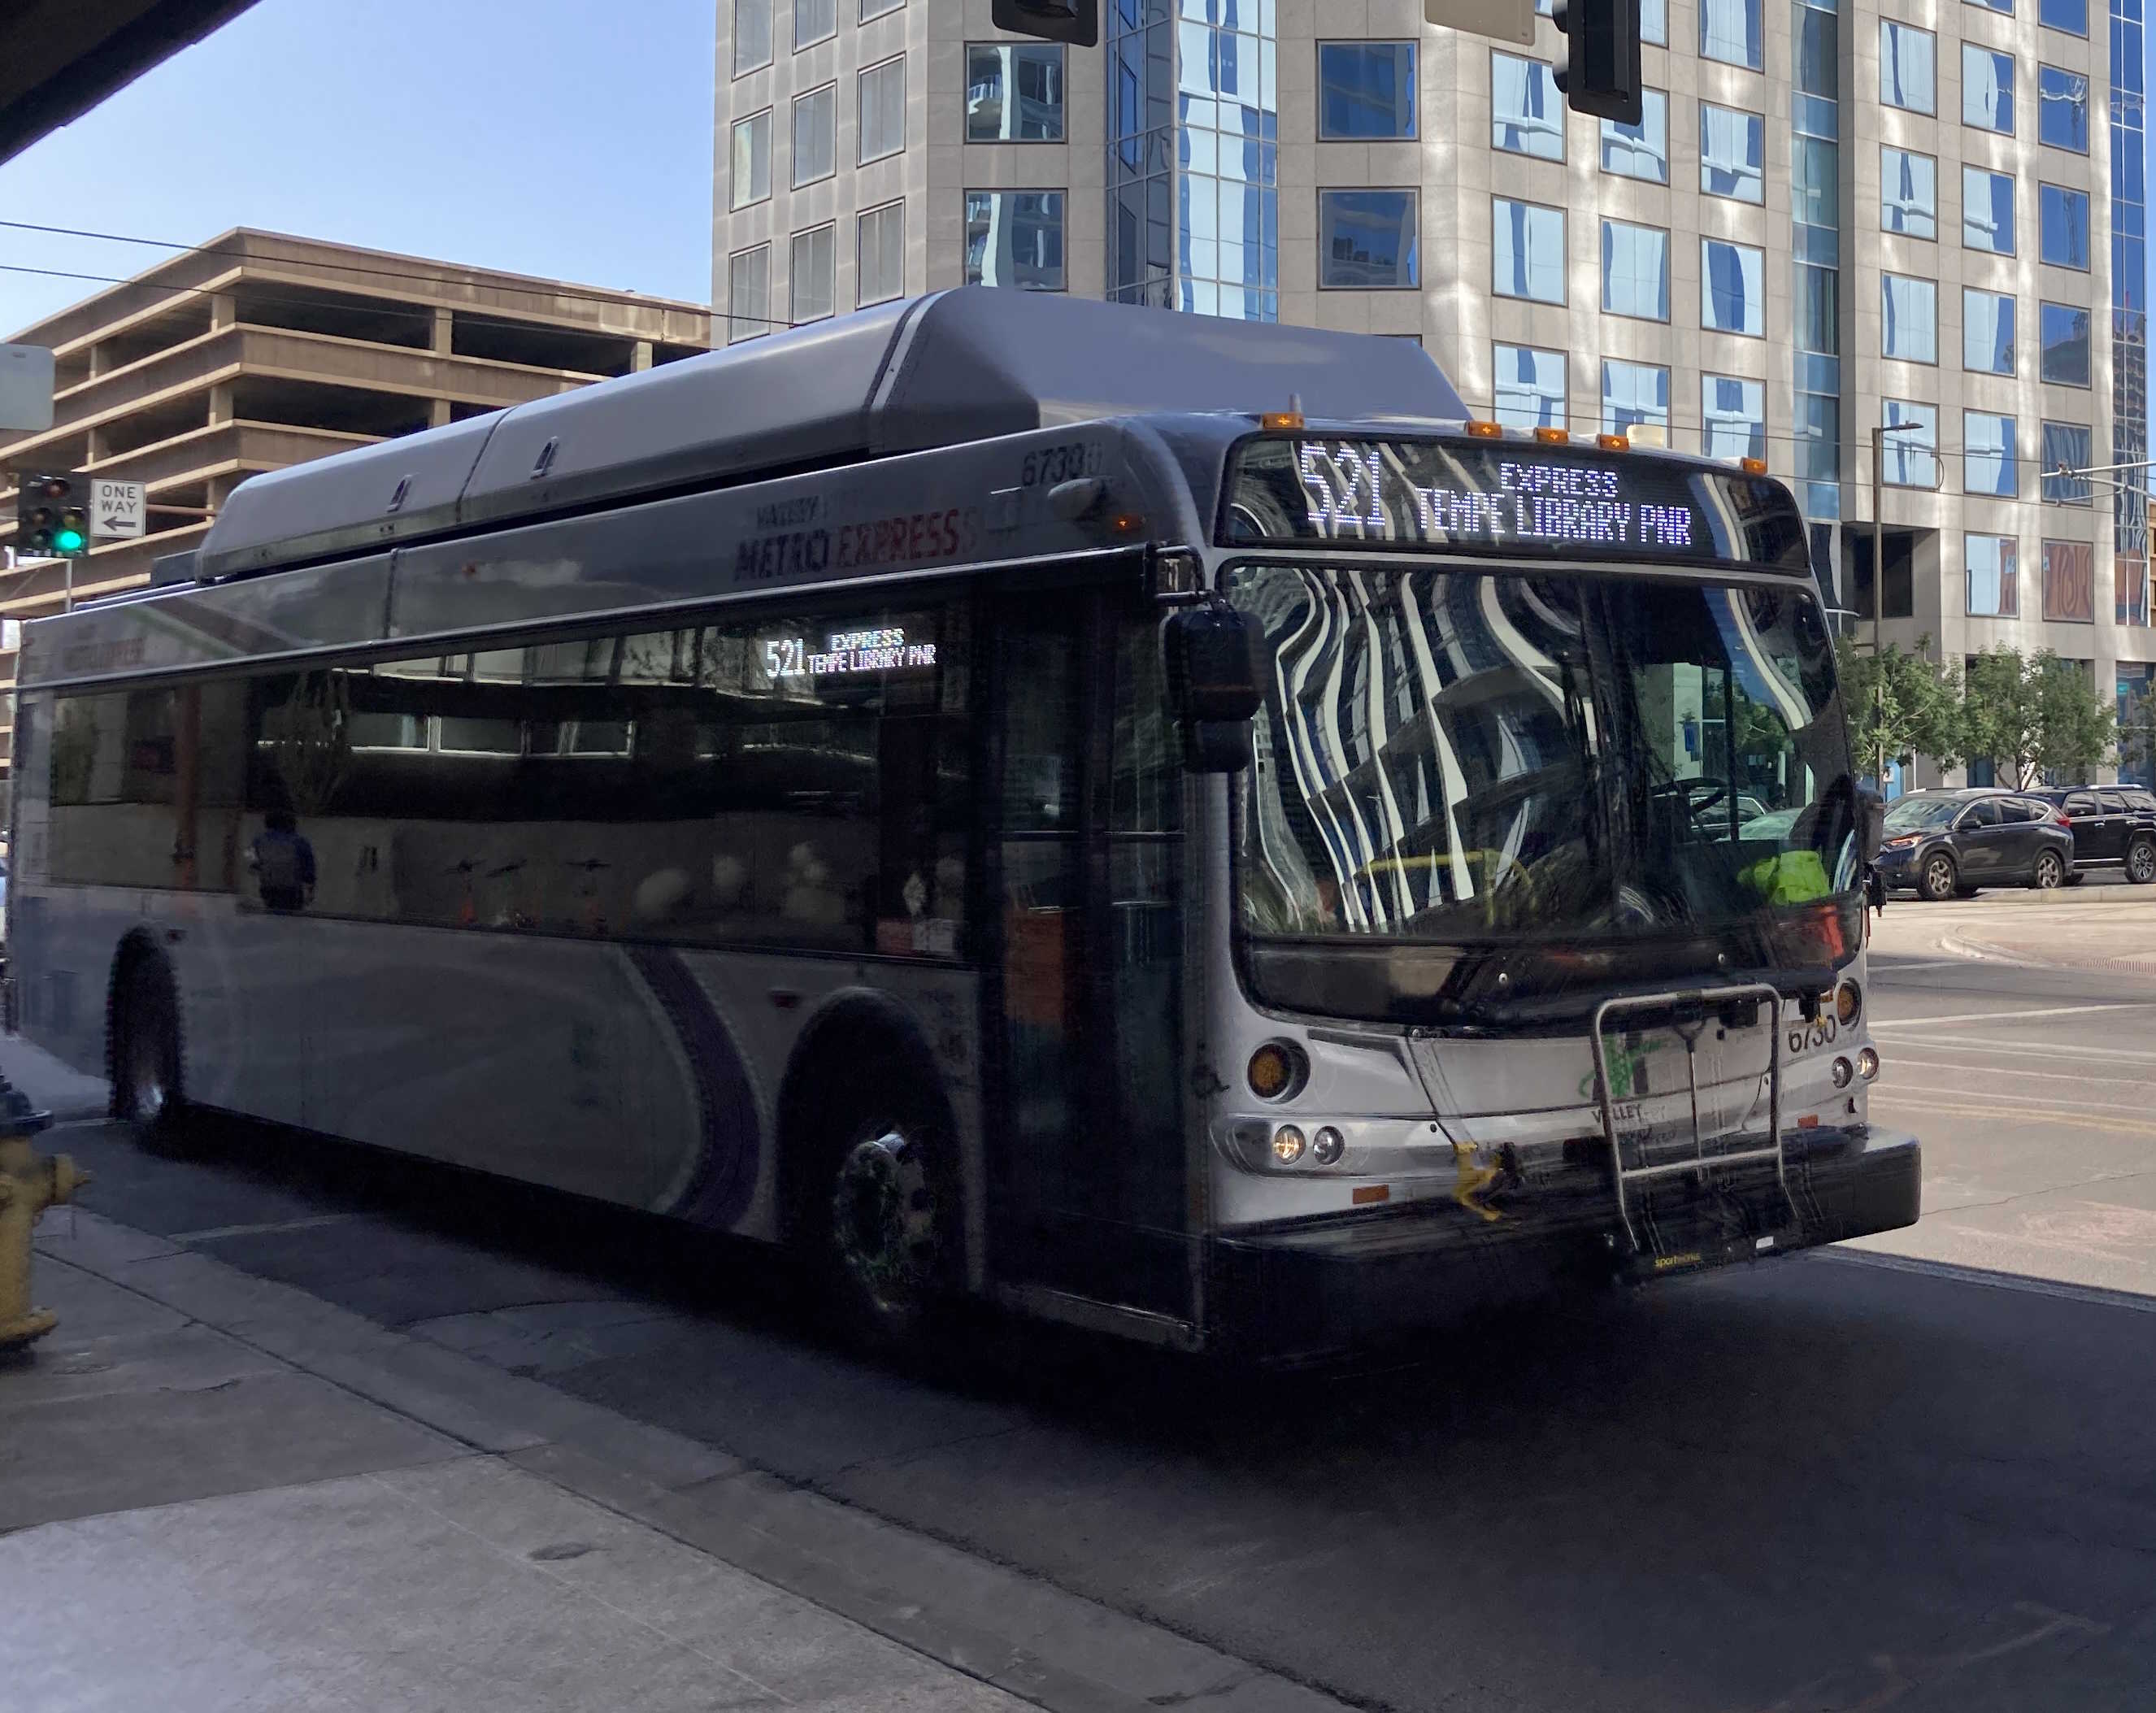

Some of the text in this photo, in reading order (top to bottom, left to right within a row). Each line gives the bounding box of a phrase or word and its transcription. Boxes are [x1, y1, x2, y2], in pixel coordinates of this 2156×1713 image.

[102, 485, 137, 499] ONE
[1301, 445, 1386, 526] 521
[1500, 462, 1619, 498] EXPRESS
[101, 499, 137, 514] WAY
[1415, 487, 1692, 546] TEMPE LIBRARY PNR
[733, 508, 959, 582] METRO EXPRESS
[831, 627, 906, 652] EXPRESS
[767, 637, 806, 678] 521
[806, 651, 847, 675] TEMPE
[850, 646, 906, 671] LIBRARY
[1591, 1103, 1642, 1124] VLLEY
